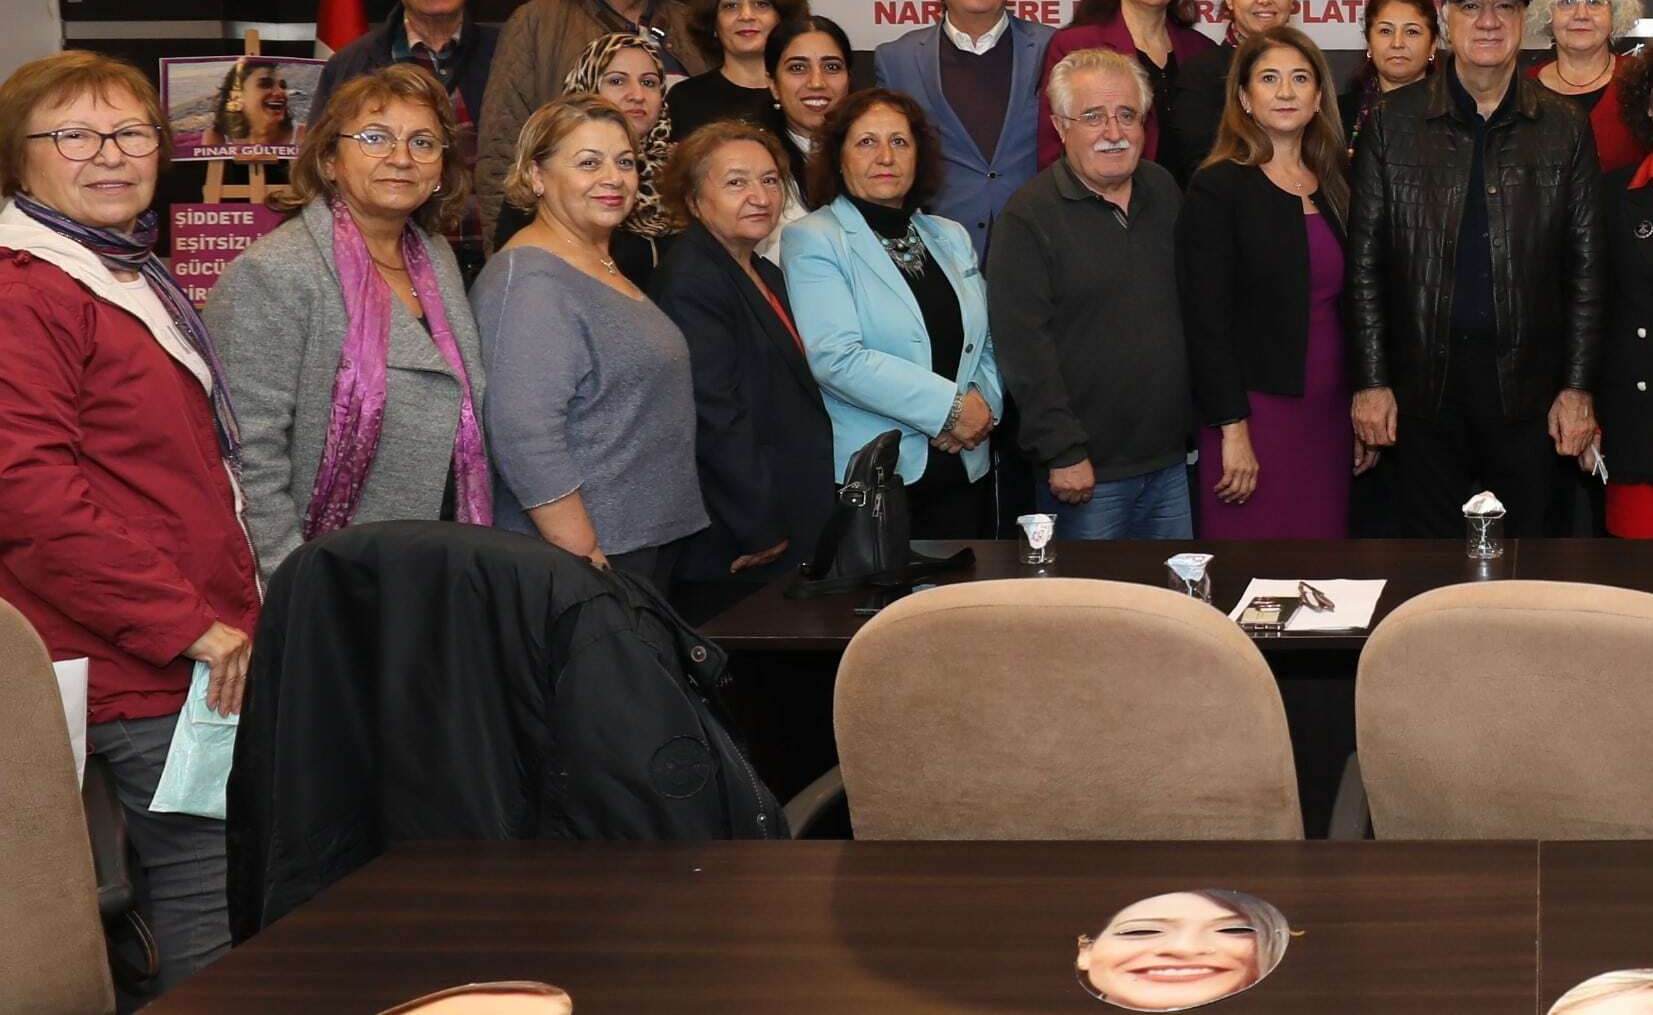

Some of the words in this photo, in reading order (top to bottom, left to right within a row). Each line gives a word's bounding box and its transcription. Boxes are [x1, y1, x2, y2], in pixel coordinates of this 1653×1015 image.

[193, 146, 238, 157] PINAR
[241, 144, 300, 156] GÜLTEKİ
[175, 208, 254, 229] ŞİDDETE
